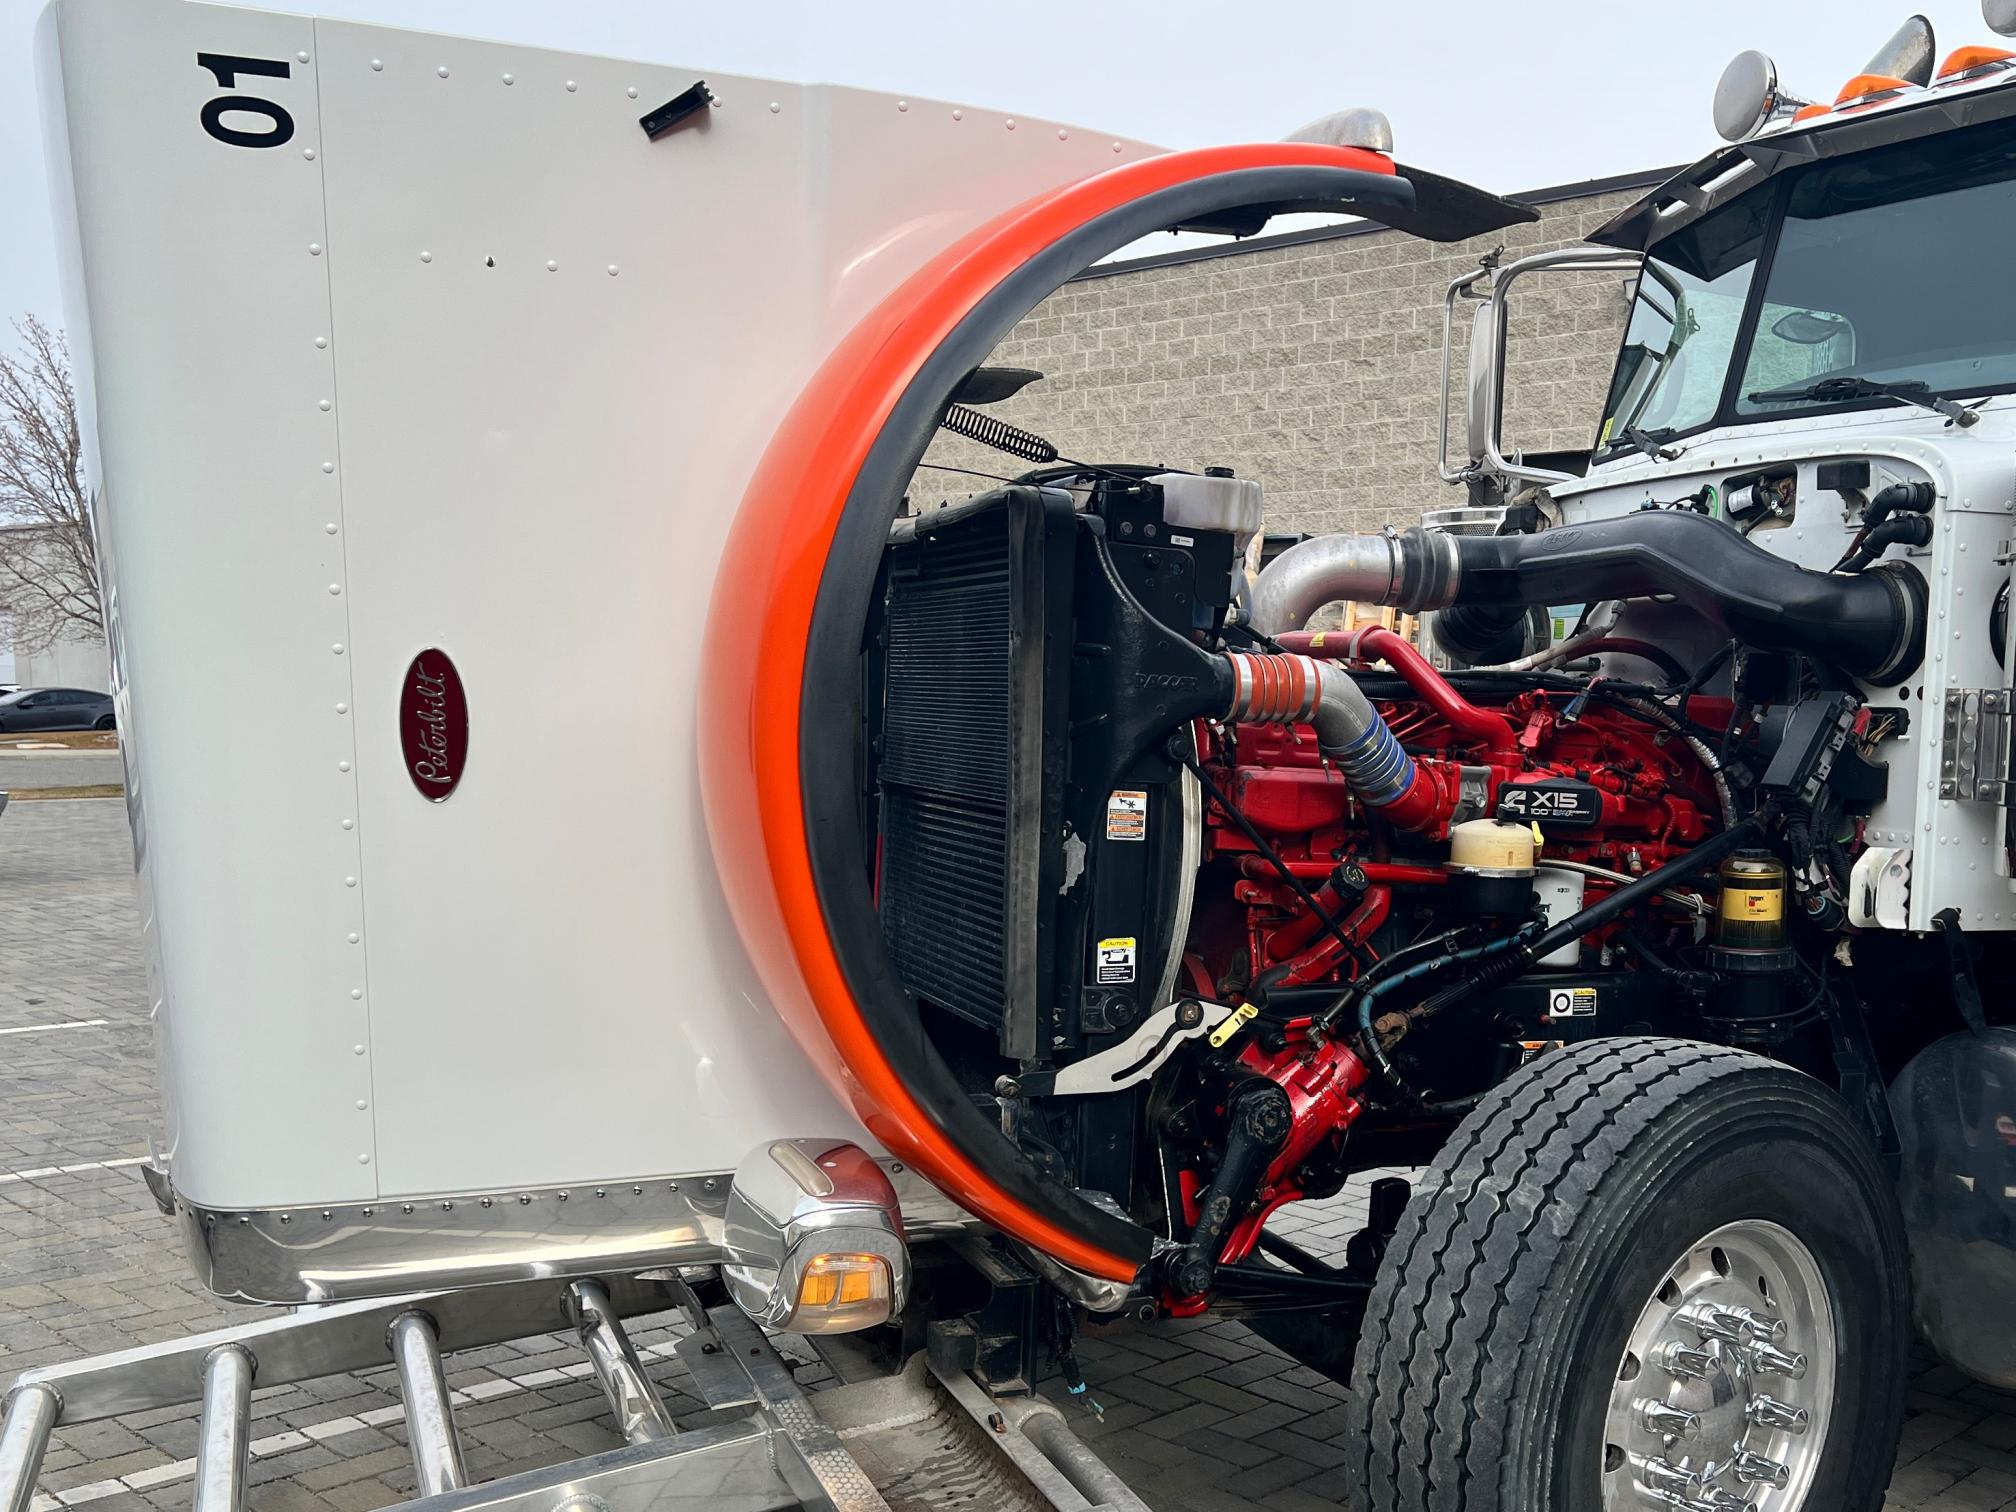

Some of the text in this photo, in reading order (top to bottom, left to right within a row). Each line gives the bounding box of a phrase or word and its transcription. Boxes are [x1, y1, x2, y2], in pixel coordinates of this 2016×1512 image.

[197, 52, 294, 148] 01
[415, 661, 451, 783] Peterbilt
[1531, 791, 1578, 808] X15
